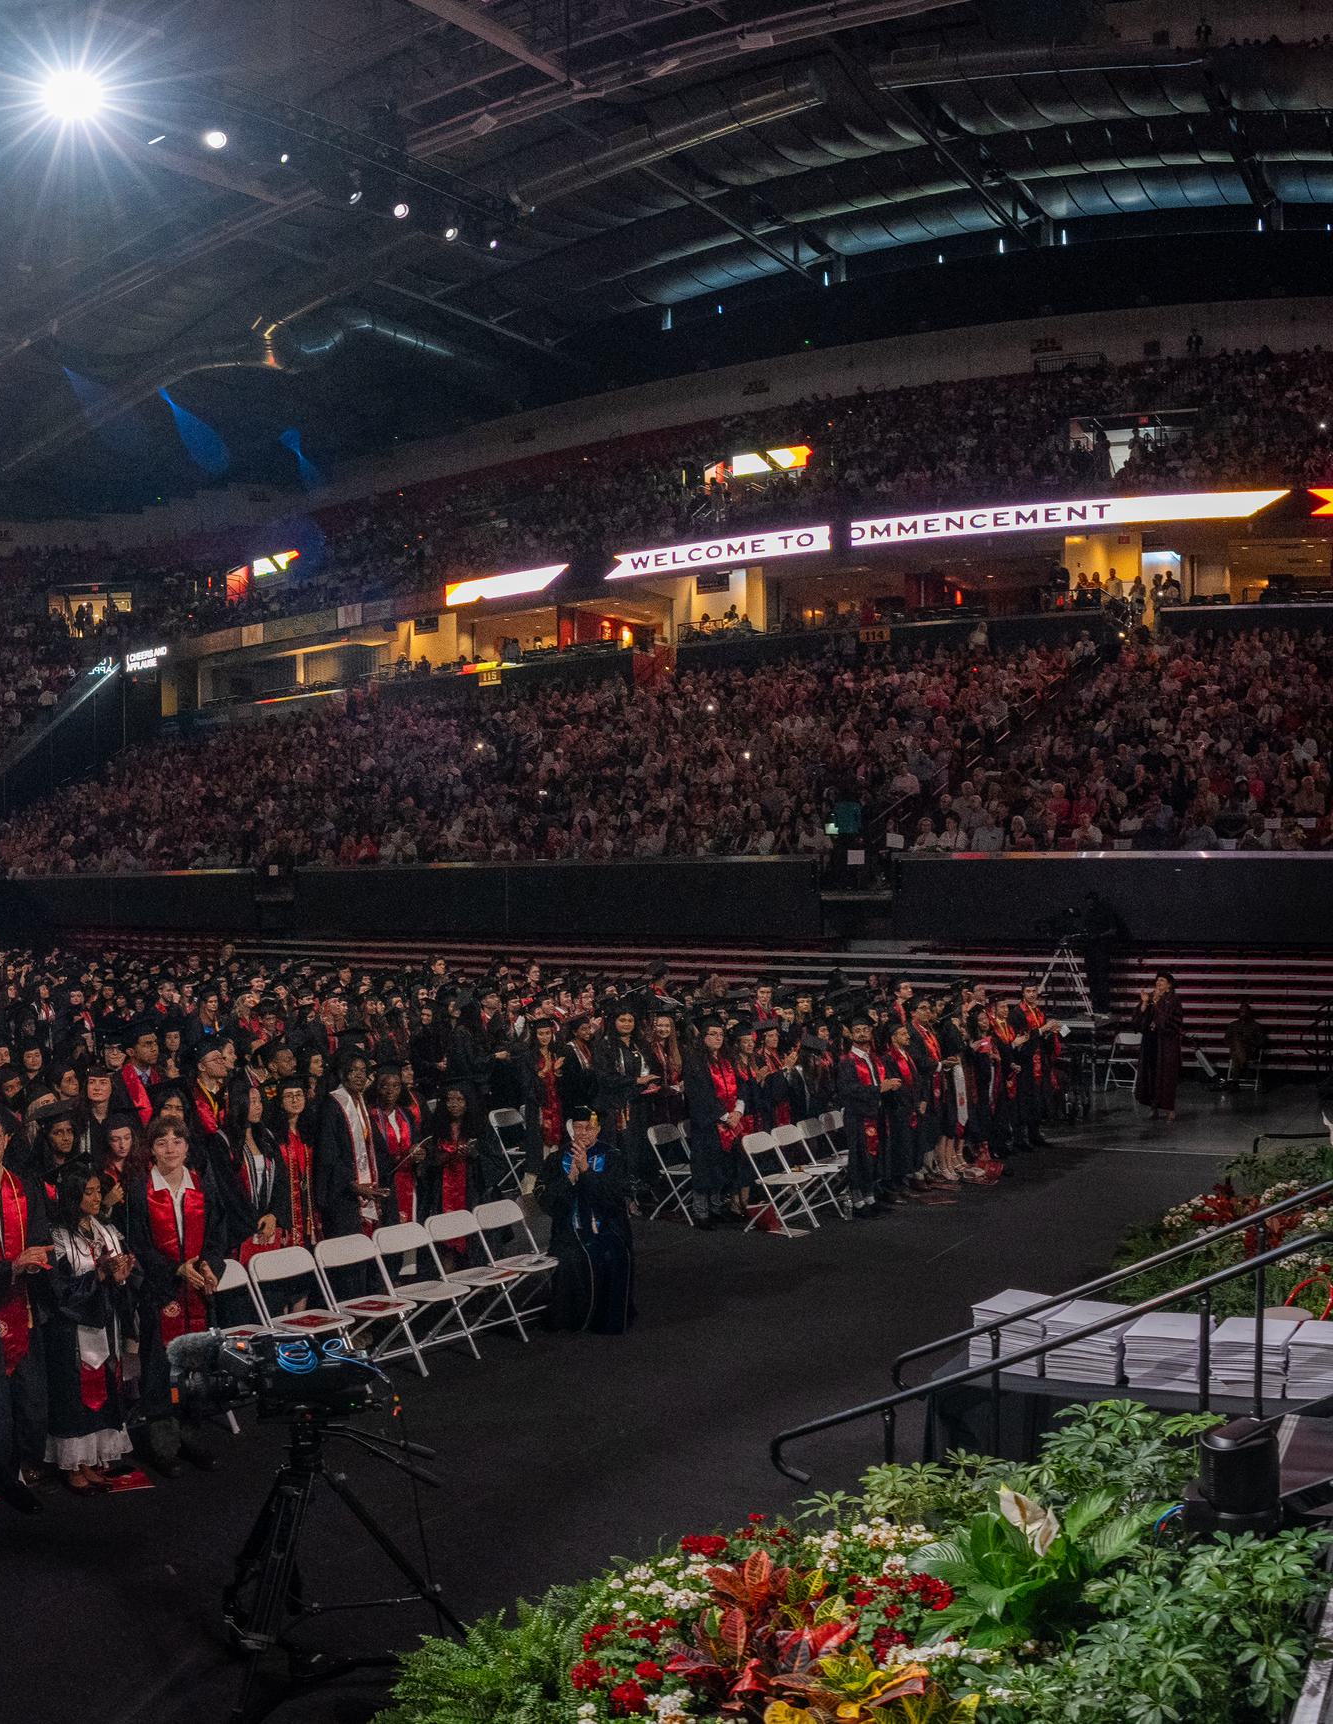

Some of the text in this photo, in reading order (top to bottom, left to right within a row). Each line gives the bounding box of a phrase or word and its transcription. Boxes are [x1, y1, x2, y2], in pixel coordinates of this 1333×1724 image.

[630, 504, 1111, 571] WELCOME TO OMMENCEMENT
[865, 630, 884, 641] 114
[153, 646, 167, 657] AND
[126, 658, 157, 673] APPLAUSE
[483, 671, 497, 681] 115
